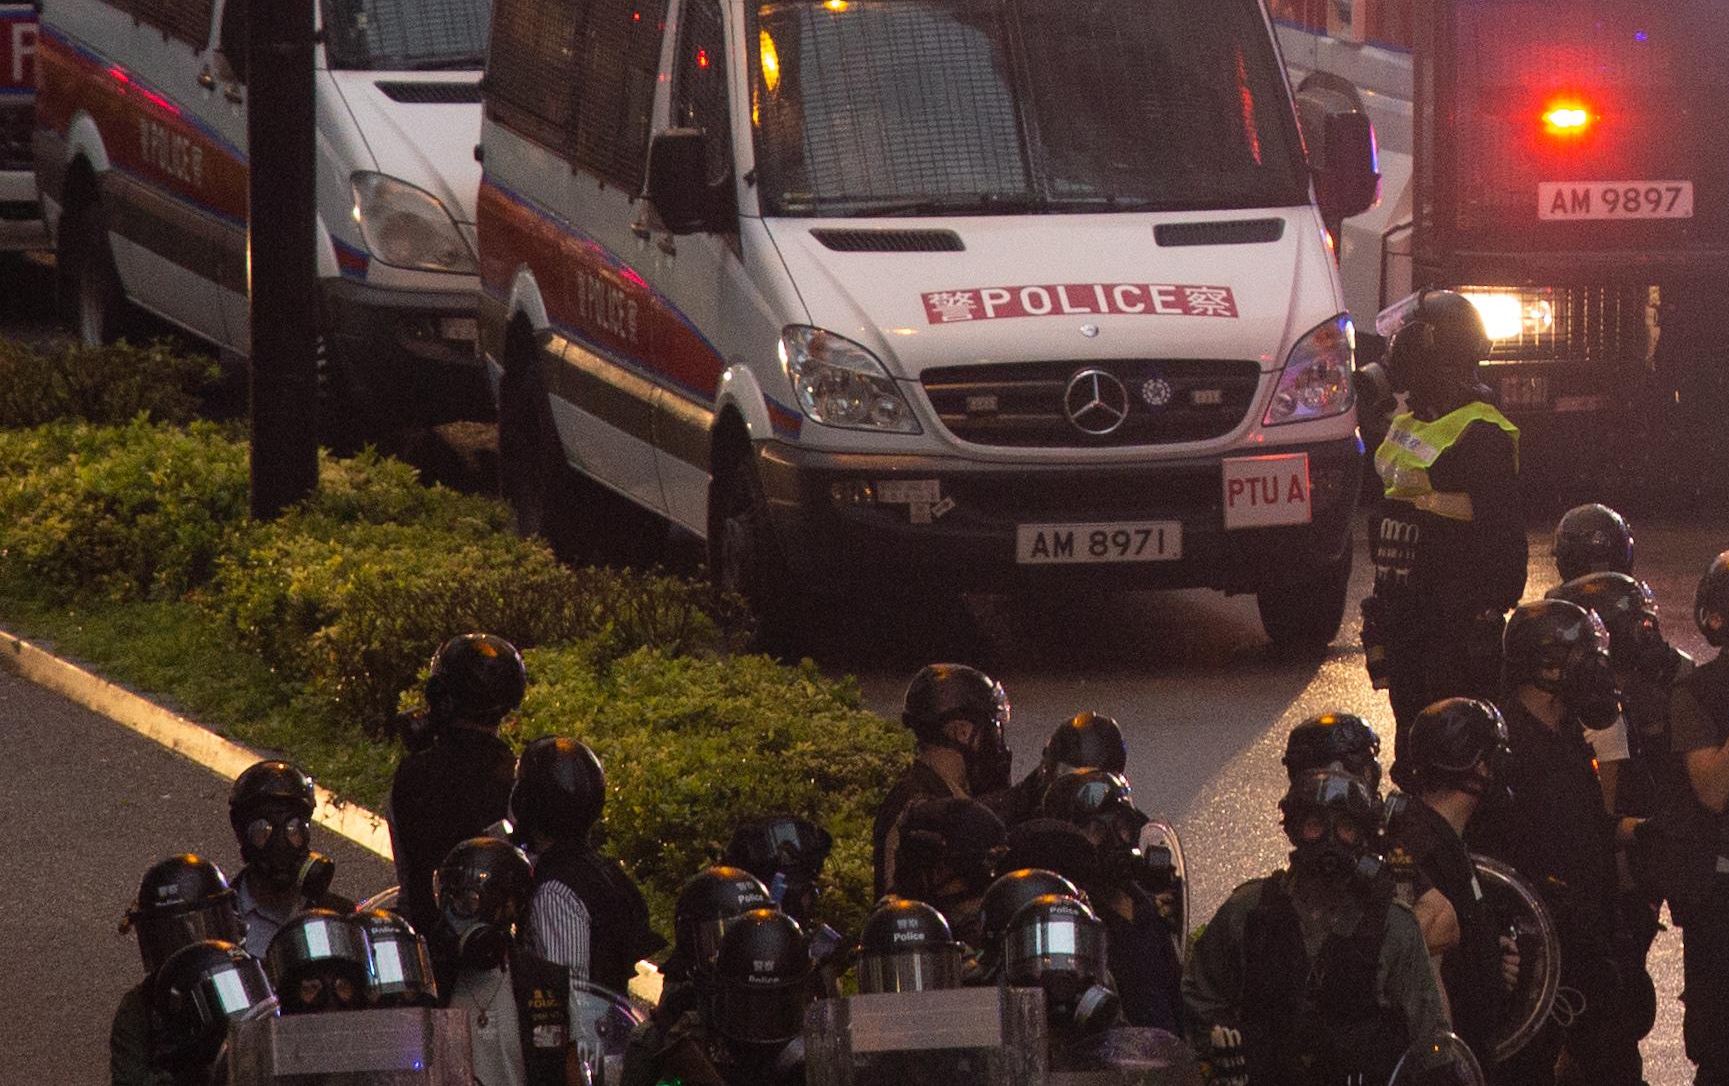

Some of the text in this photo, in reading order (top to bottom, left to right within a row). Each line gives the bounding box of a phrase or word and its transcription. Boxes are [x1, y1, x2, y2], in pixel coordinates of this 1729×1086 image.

[1550, 186, 1683, 214] AM 9897
[928, 284, 1232, 323] 警 POLICE 察
[1228, 473, 1306, 508] PTU A
[1030, 528, 1166, 559] AM 8971
[893, 931, 925, 943] Police
